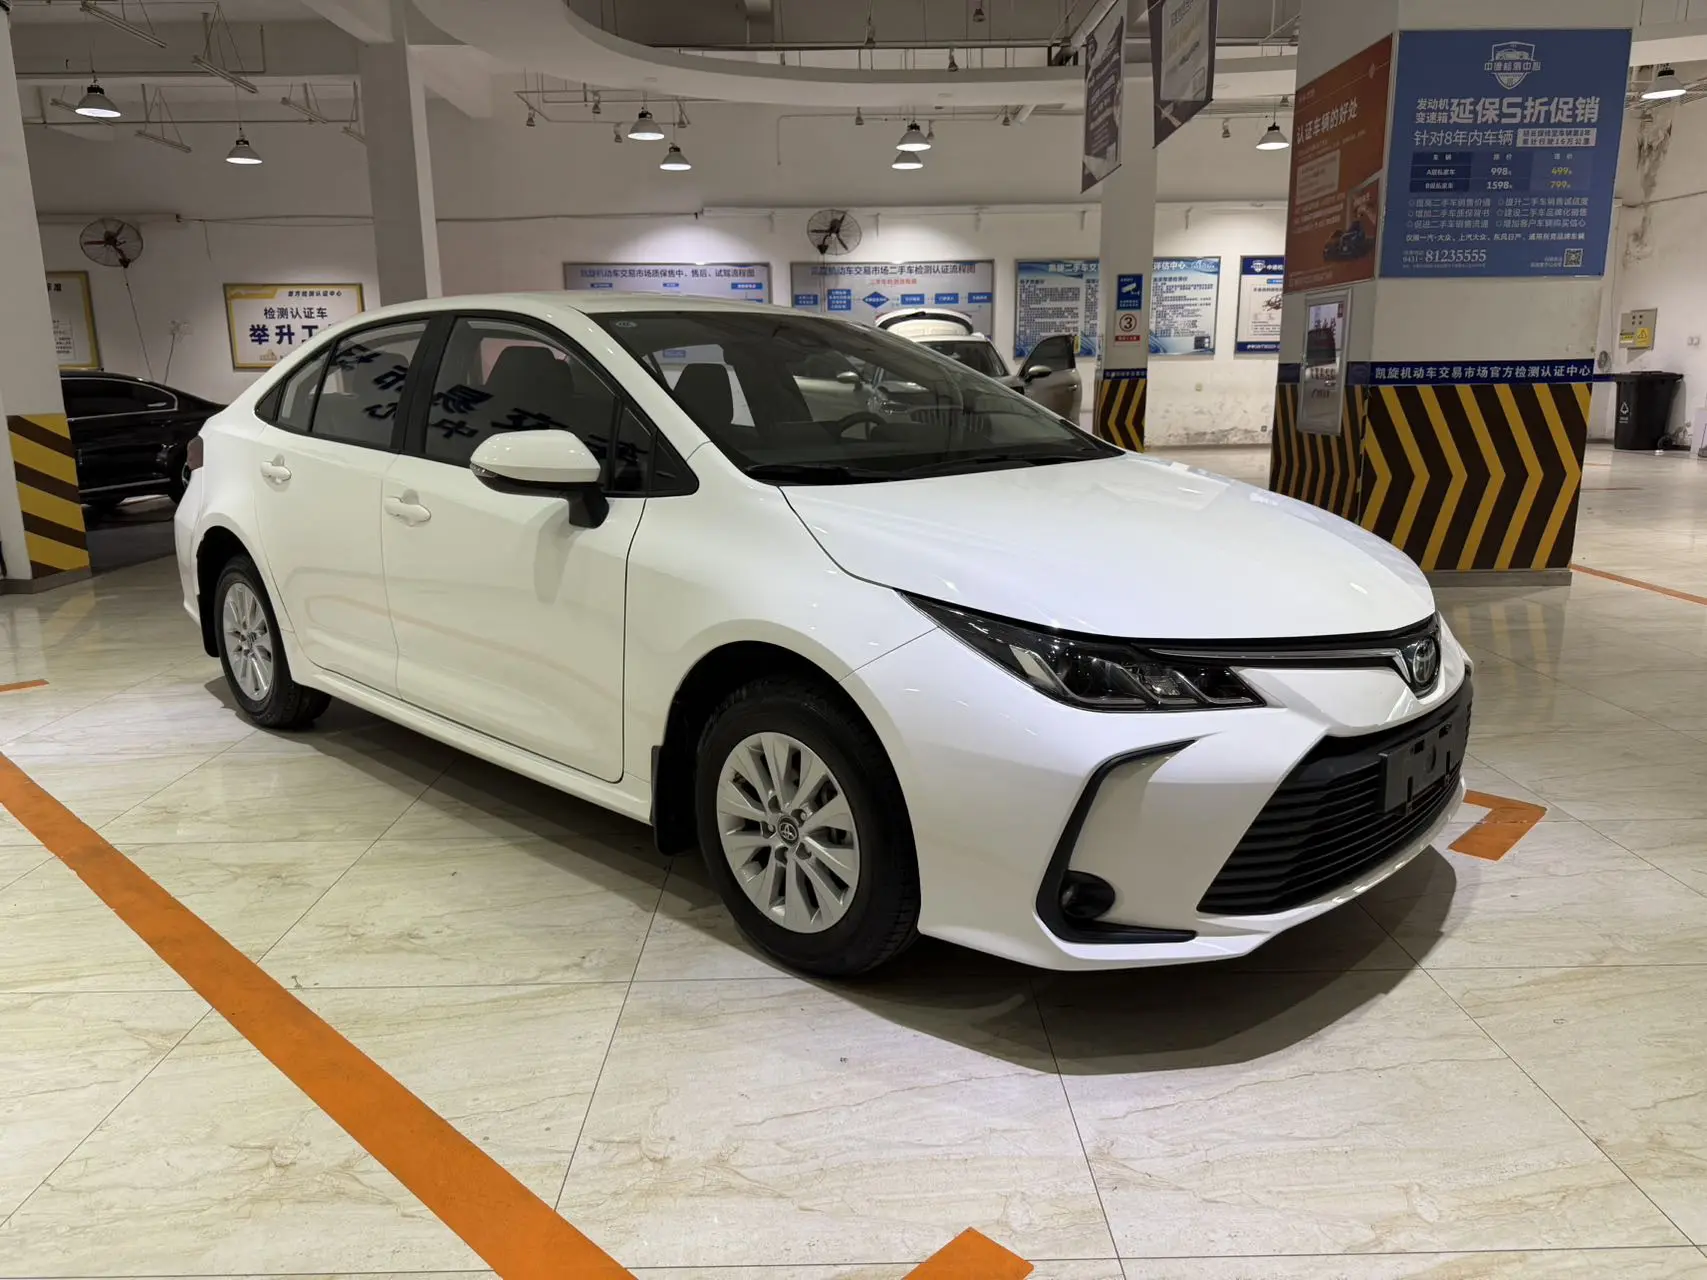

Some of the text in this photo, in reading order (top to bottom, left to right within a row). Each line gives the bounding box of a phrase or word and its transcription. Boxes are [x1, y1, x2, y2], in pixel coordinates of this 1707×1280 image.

[1416, 96, 1600, 124] 发动机 延保5折促销
[1296, 98, 1358, 144] 认证车辆的好处
[1415, 112, 1449, 124] 变速箱
[1413, 130, 1514, 147] 针对8年内车辆
[1424, 249, 1487, 263] 81235555
[263, 307, 329, 320] 检测认证车
[1374, 365, 1593, 379] 凯旋机动车交易市场官方检测认证中心
